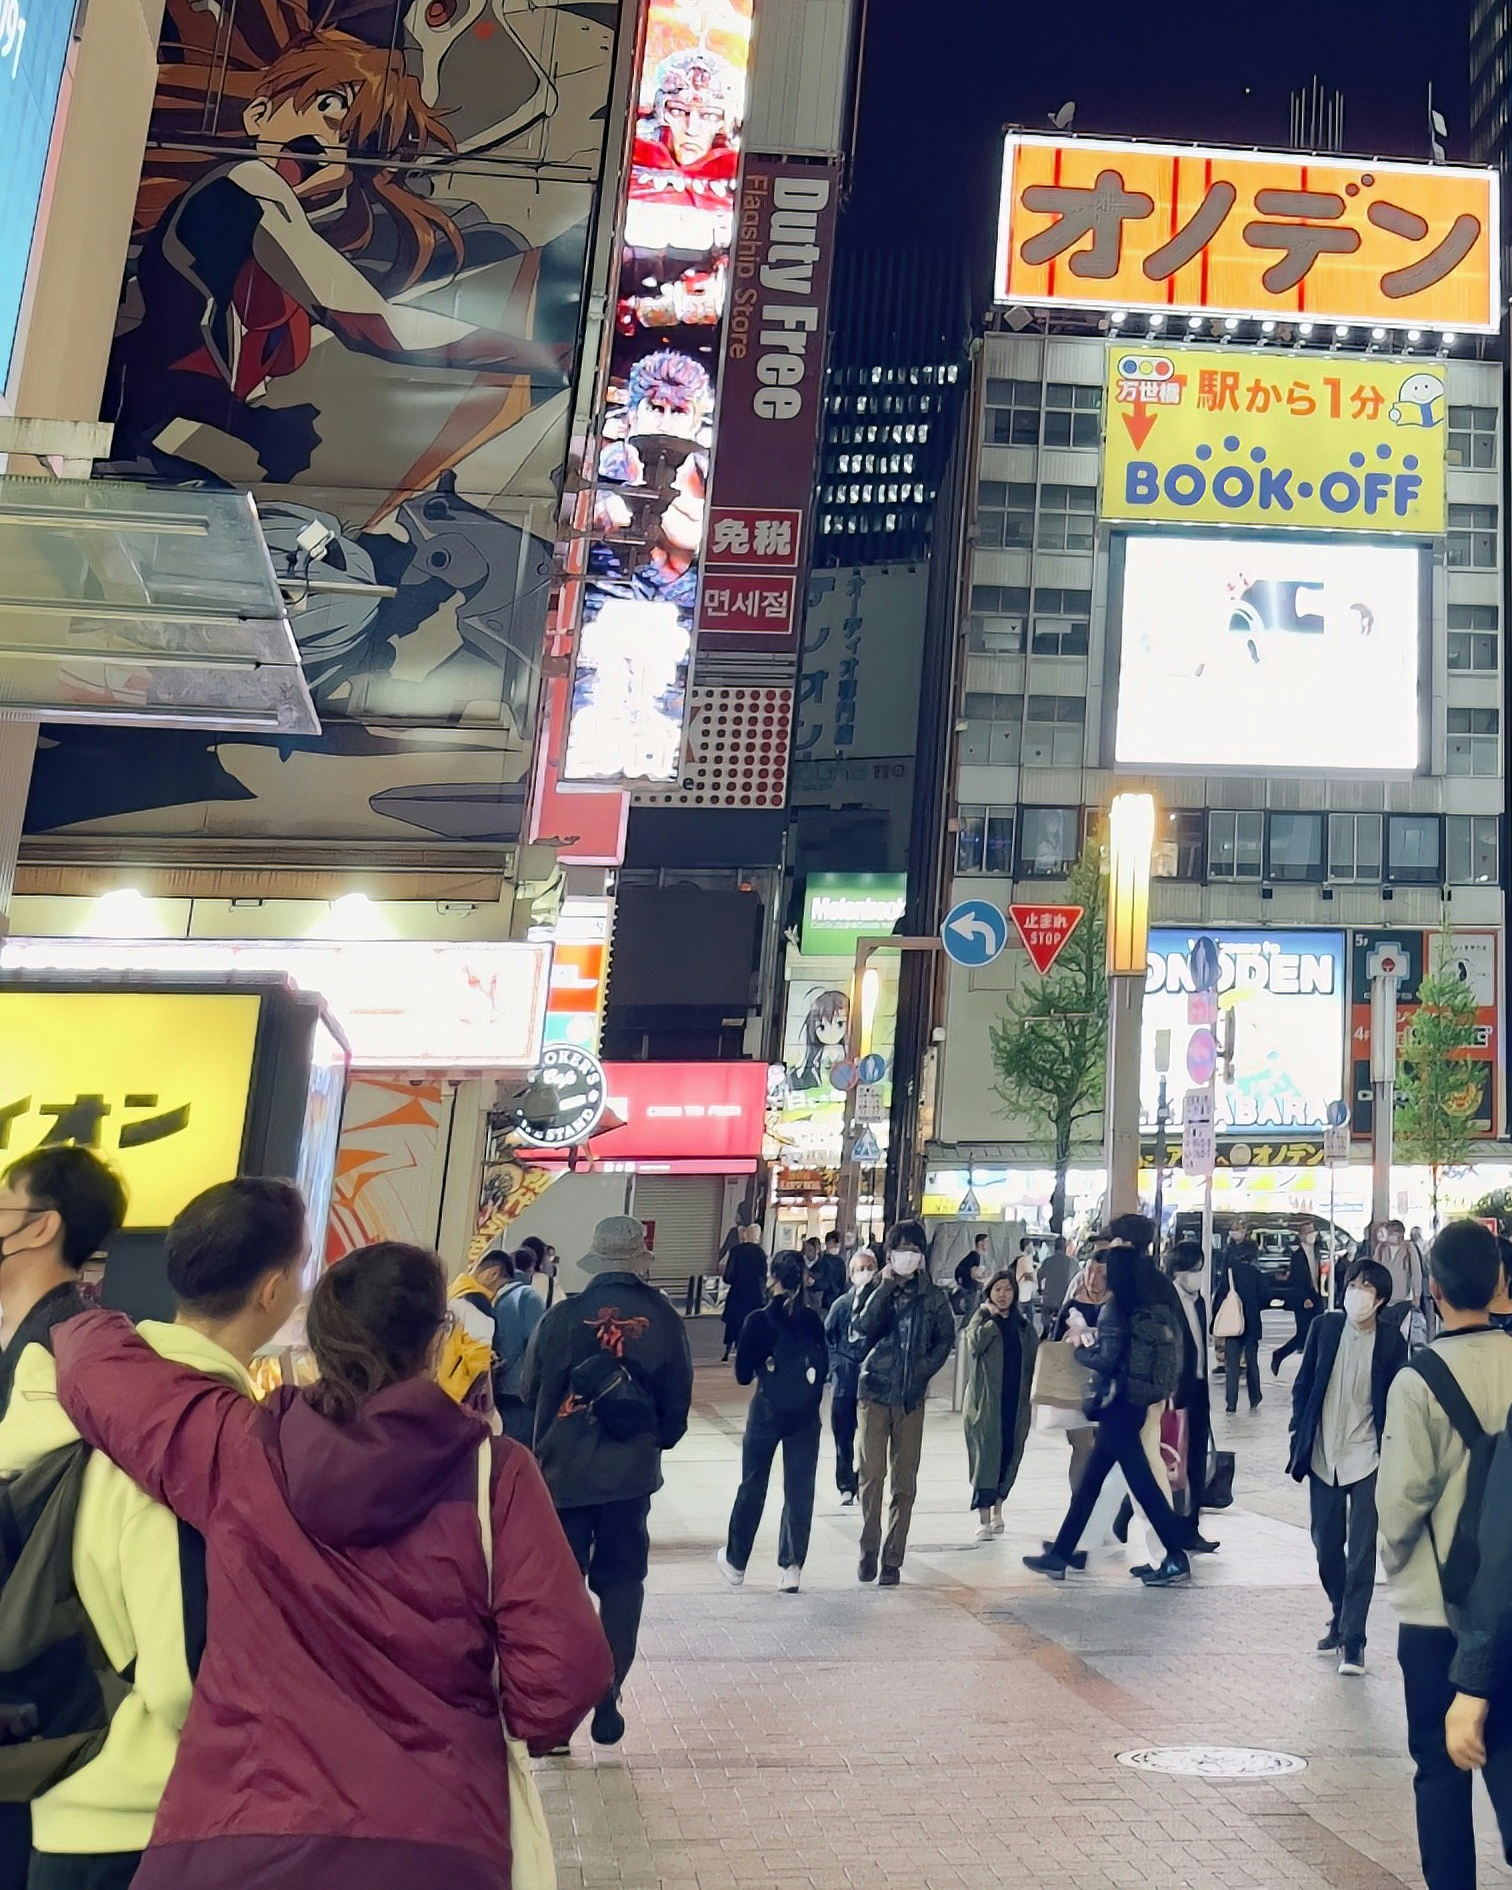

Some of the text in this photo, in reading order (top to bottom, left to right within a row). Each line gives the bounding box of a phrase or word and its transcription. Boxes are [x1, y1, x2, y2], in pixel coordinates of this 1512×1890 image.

[1019, 167, 1482, 300] オノデン
[728, 173, 769, 360] Flagship Store
[753, 176, 831, 420] Duty Free
[1197, 367, 1385, 421] 駅から1分
[713, 517, 793, 558] 免税
[703, 585, 790, 621] 면세점
[1023, 913, 1069, 930] 止まれ
[1029, 932, 1062, 947] STOP
[1252, 1143, 1325, 1166] オノデン
